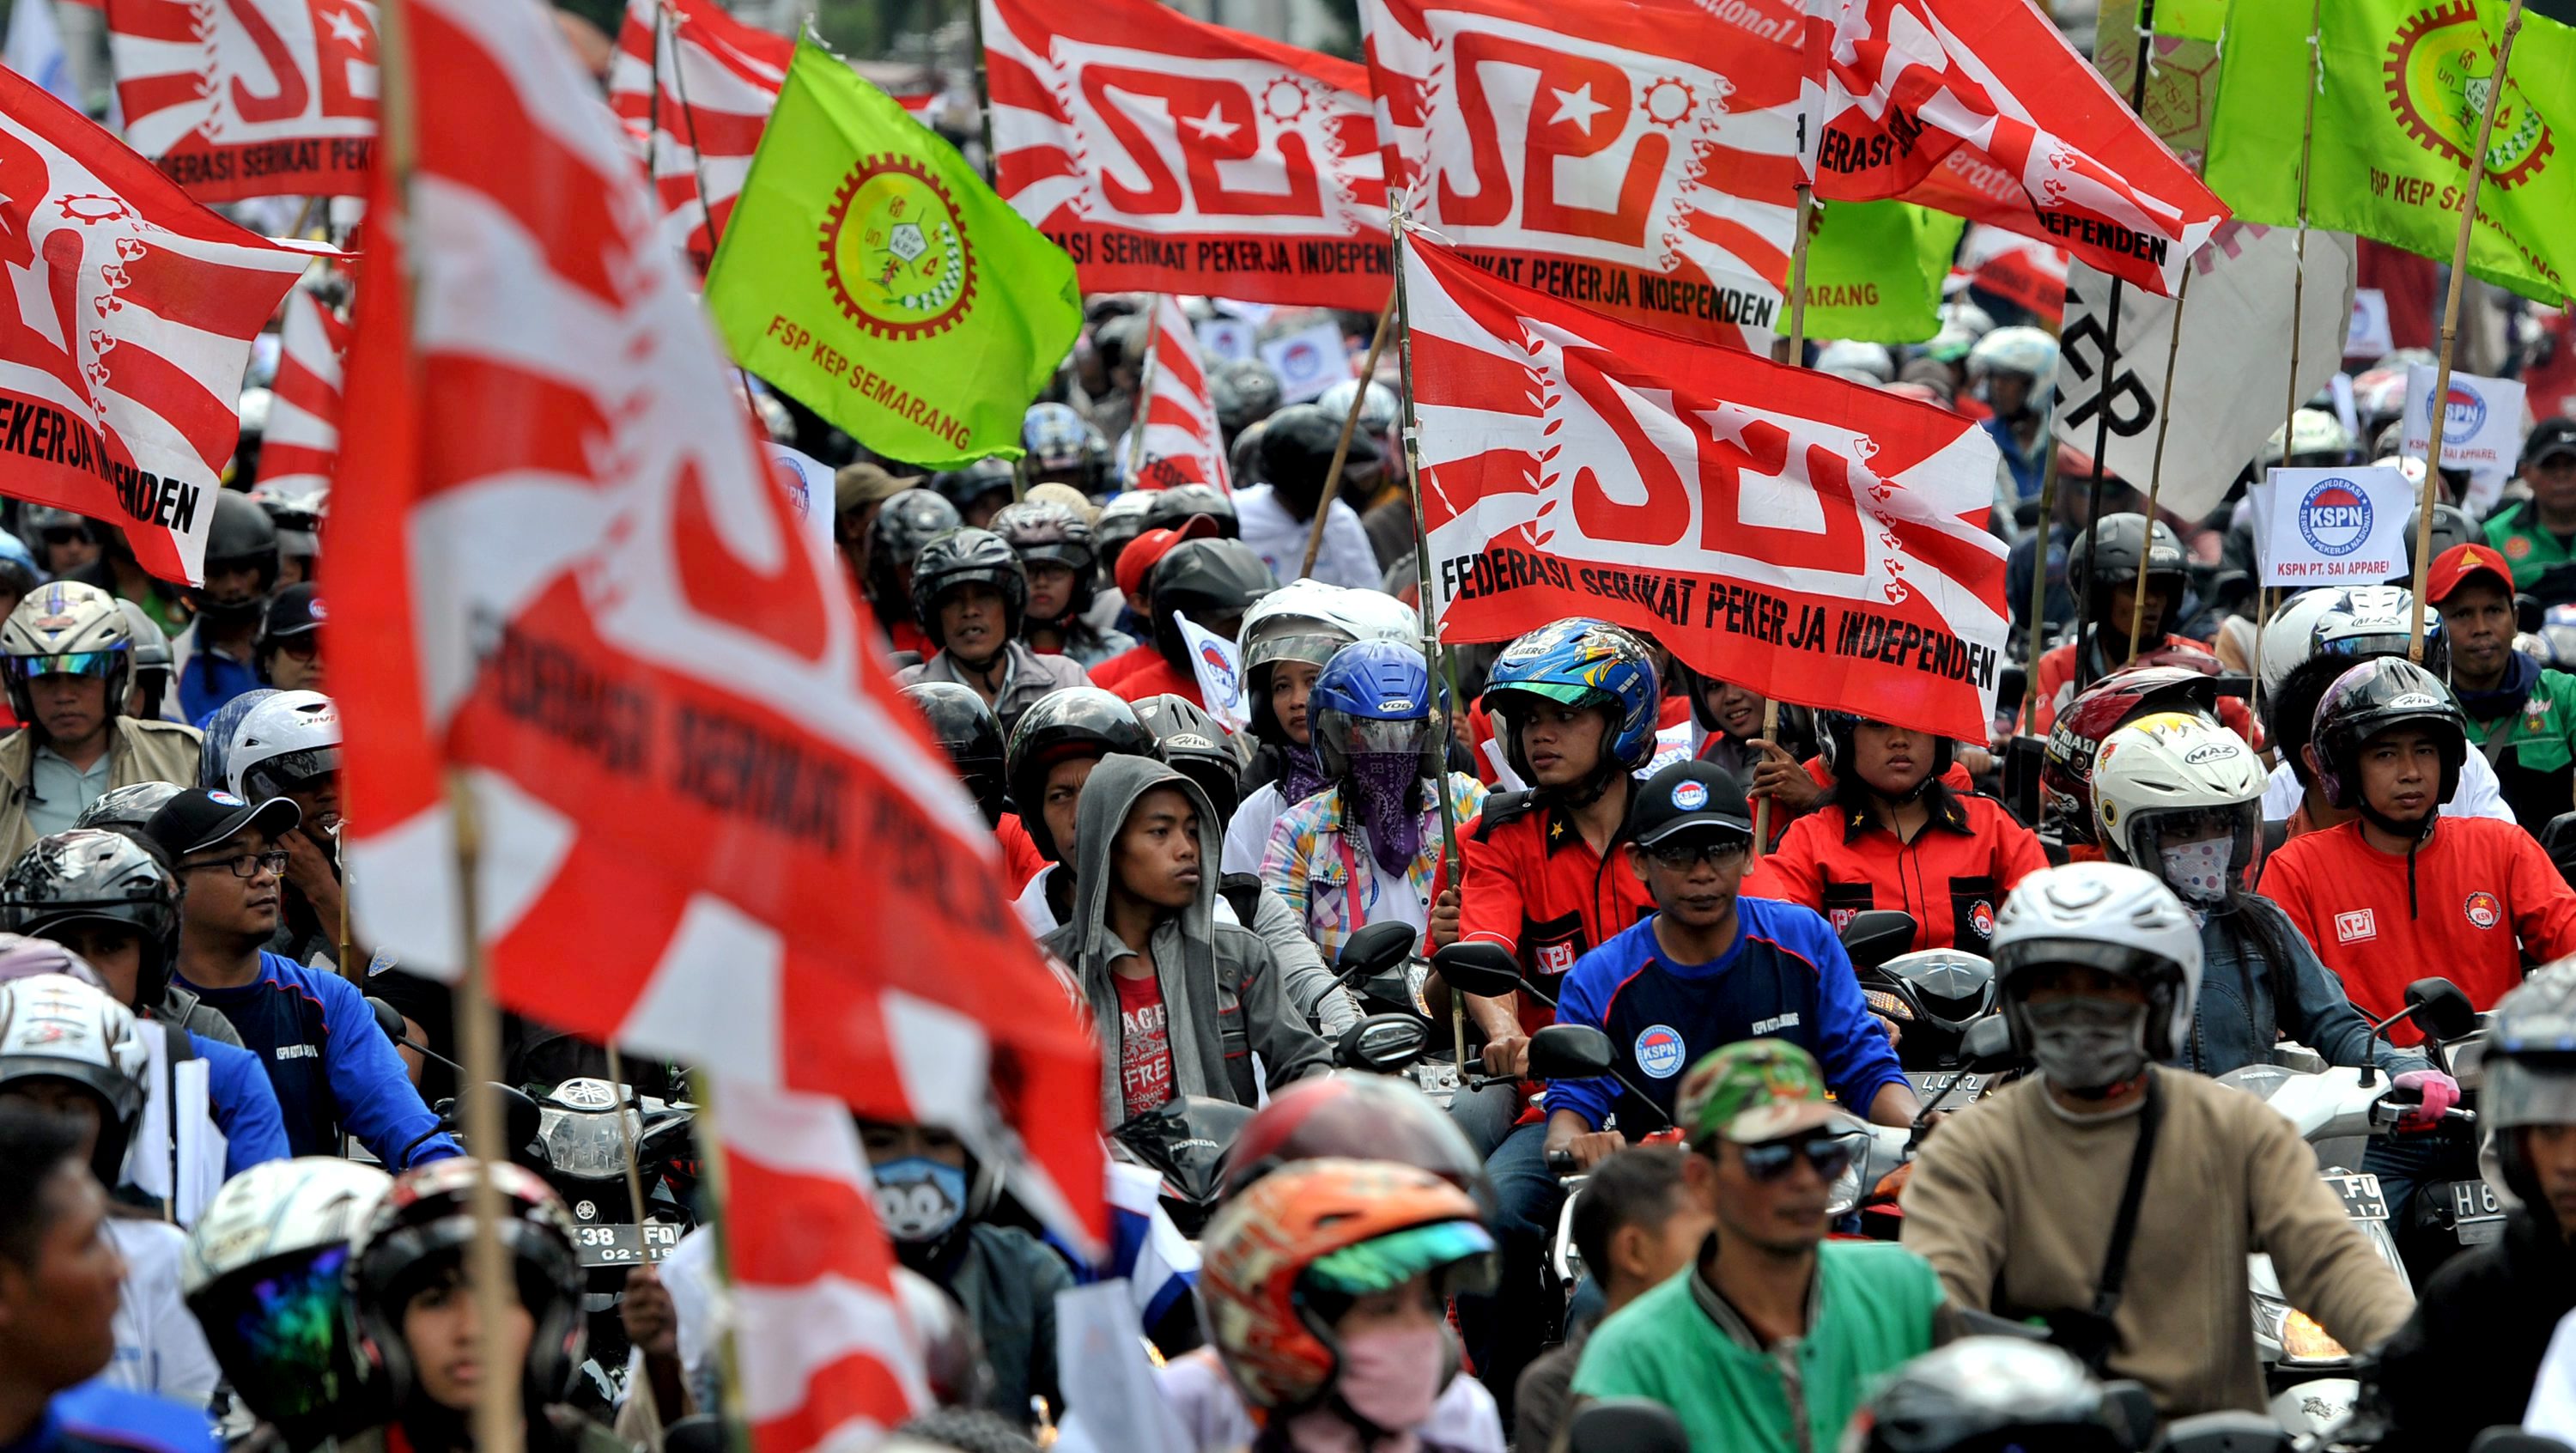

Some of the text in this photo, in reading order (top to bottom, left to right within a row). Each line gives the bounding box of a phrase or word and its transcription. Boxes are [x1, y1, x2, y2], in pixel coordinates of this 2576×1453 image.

[241, 140, 320, 178] SERIKAT
[2393, 174, 2435, 207] KEP
[1102, 232, 1188, 271] SERIKAT
[1199, 241, 1291, 273] PEKERJA
[1531, 259, 1631, 307] PEKERJA
[1638, 272, 1775, 329] INDEPENDEN
[766, 314, 971, 451] FSP KEP SEMARANG
[2308, 478, 2364, 500] KONFEDERASI
[2309, 506, 2363, 528] KSPN
[2300, 508, 2372, 555] SERIKAT PEKERJA NASIONAL
[2277, 562, 2306, 576] KSPN
[2309, 562, 2325, 576] PT.
[2327, 562, 2345, 575] SAI
[1442, 548, 1997, 691] FEDERASI SERIKAT PEKERJA INDEPENDEN
[2190, 745, 2235, 763] MAZ
[1679, 789, 1701, 801] KSPN
[2476, 911, 2490, 921] KSN
[1643, 1043, 1677, 1061] KSPN
[1169, 1138, 1219, 1152] HONDA
[2454, 1184, 2475, 1217] H
[642, 1225, 676, 1245] FQ
